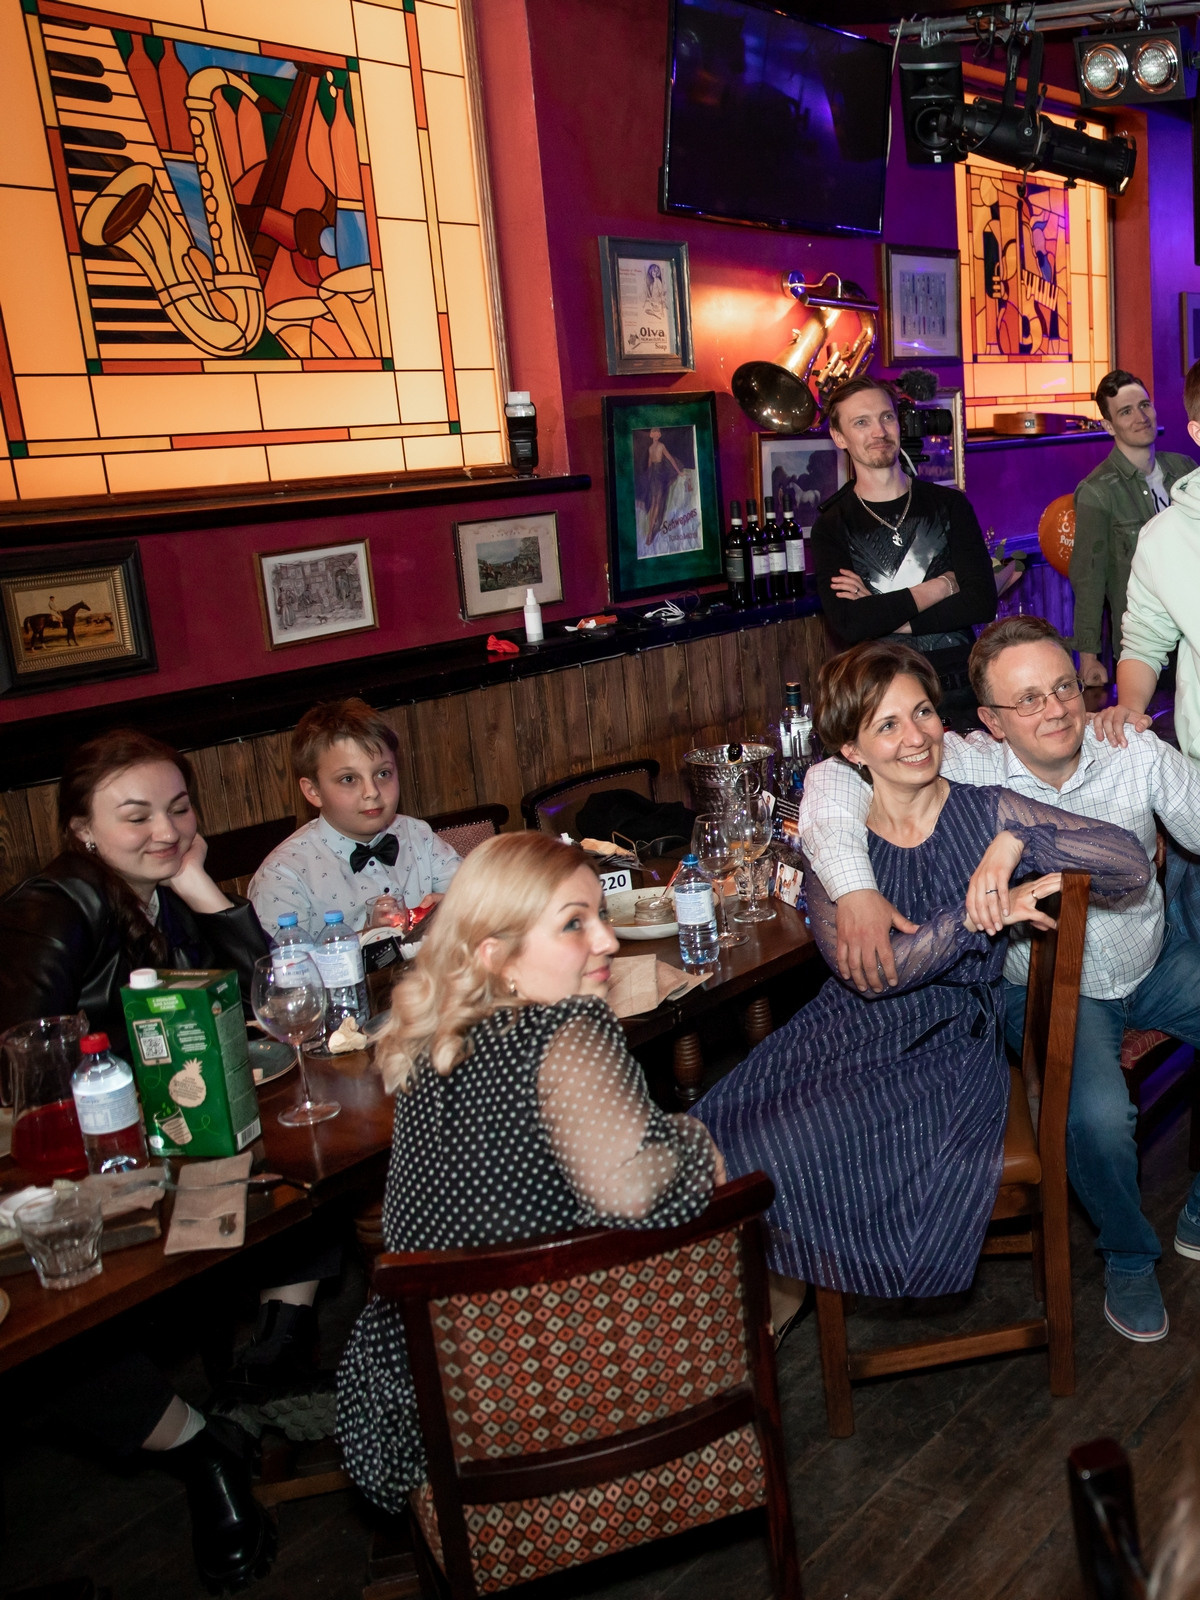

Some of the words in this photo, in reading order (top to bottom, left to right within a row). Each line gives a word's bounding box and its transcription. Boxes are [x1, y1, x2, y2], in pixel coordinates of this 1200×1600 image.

[640, 326, 665, 338] Olva
[662, 508, 698, 535] Schweppes
[600, 874, 627, 891] 220
